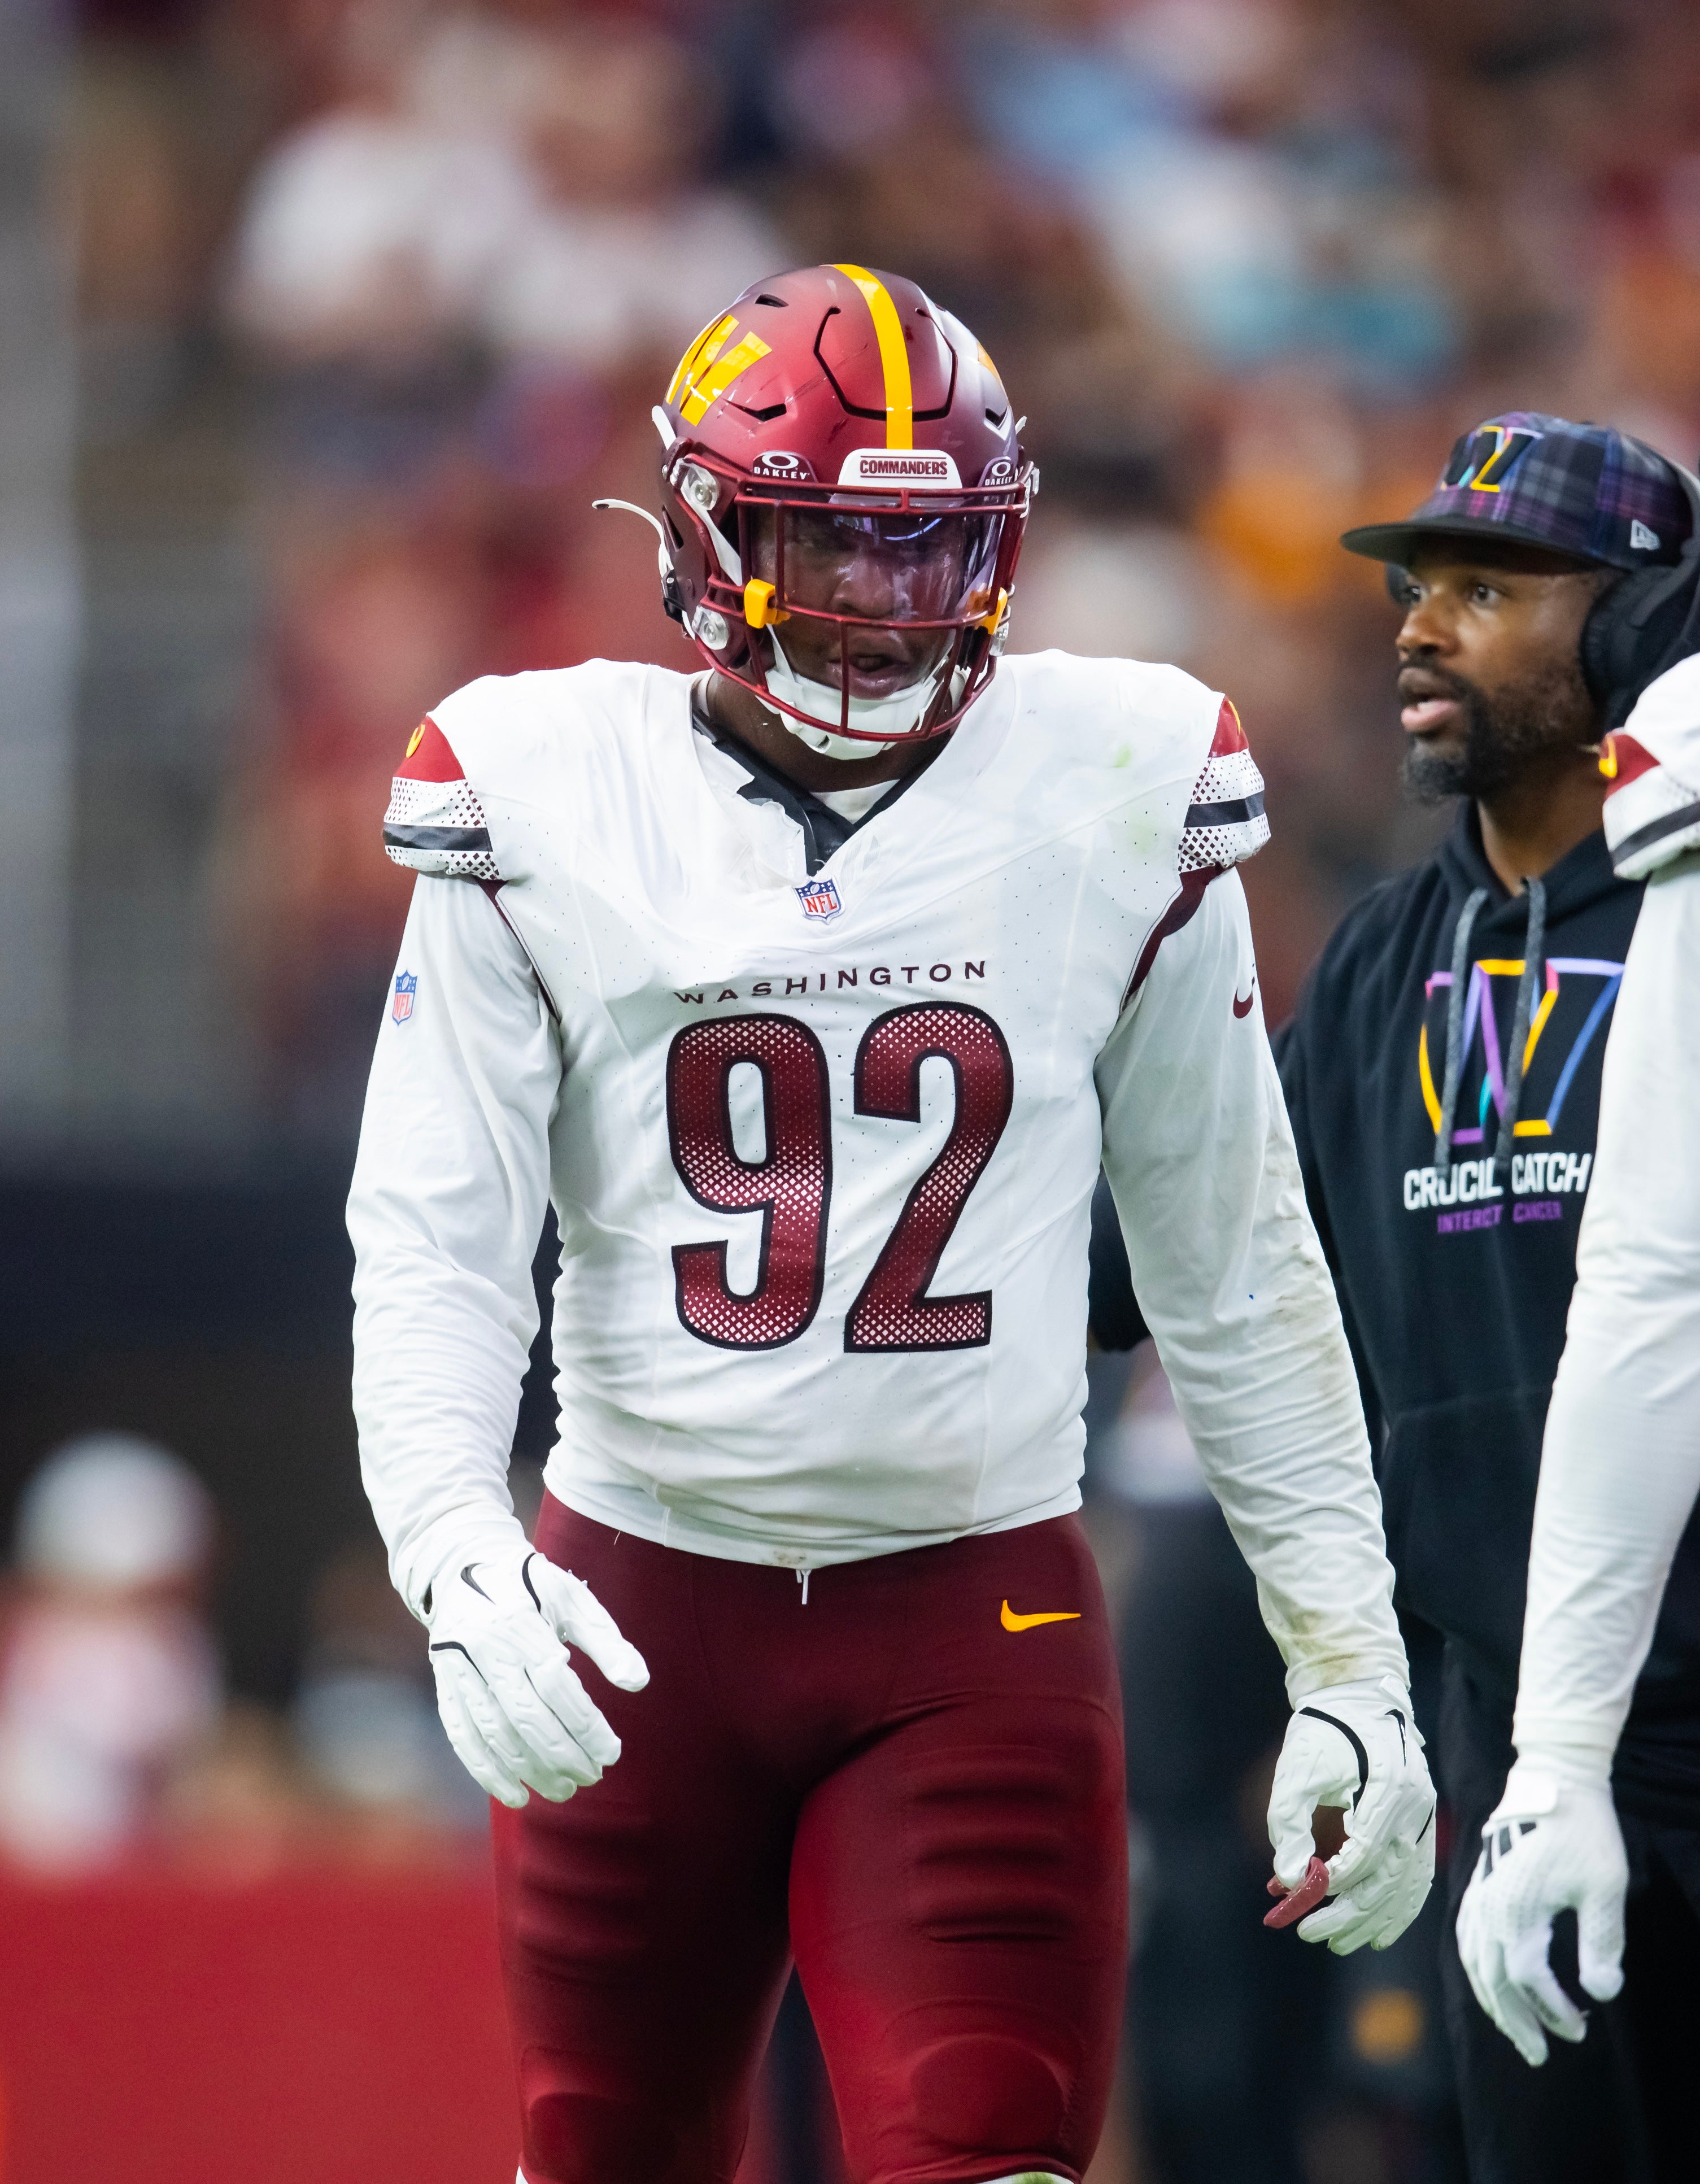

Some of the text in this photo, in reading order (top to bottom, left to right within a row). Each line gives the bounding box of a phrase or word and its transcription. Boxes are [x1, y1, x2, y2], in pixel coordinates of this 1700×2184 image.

[754, 467, 808, 480] OAKLEY
[860, 459, 948, 476] COMMANDERS
[984, 476, 1013, 486] OAKLEY
[804, 893, 838, 914] NFL
[673, 960, 985, 1004] WASHINGTON
[394, 994, 411, 1019] NFL
[665, 1000, 1014, 1353] 92
[1511, 1152, 1593, 1195] CATCH
